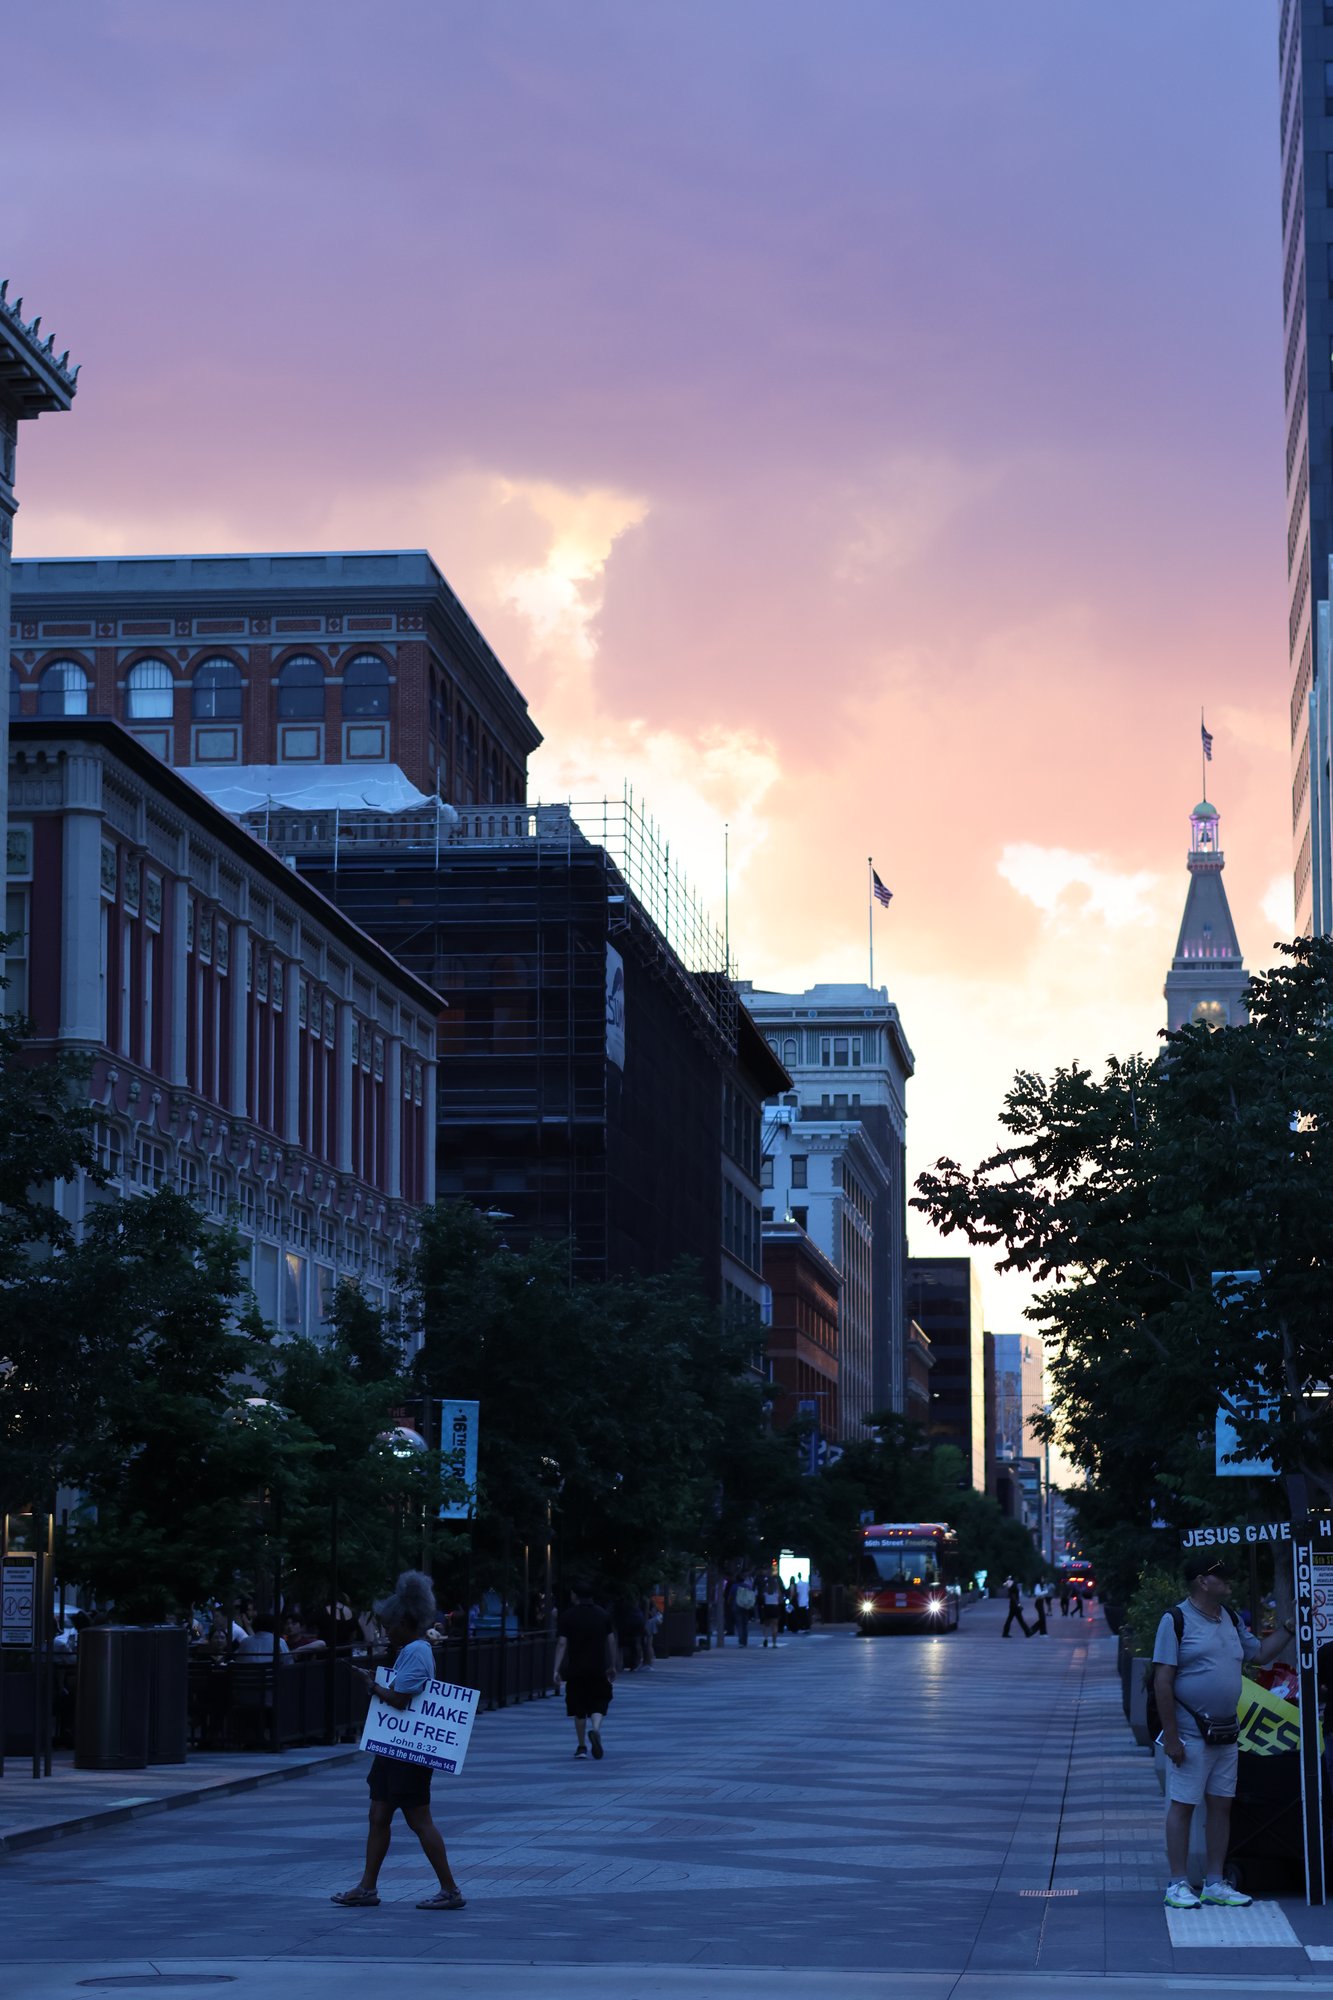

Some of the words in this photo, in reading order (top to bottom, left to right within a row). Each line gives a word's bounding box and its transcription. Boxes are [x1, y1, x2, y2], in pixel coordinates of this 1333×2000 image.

[1182, 1527, 1241, 1548] JESUS
[1245, 1522, 1292, 1543] GAVE
[1298, 1546, 1311, 1598] FOR
[1300, 1606, 1312, 1669] YOU
[420, 1700, 469, 1725] MAKE
[377, 1711, 410, 1733] YOU
[413, 1721, 459, 1746] FREE.
[367, 1742, 388, 1754] Jesus
[388, 1747, 396, 1756] is
[396, 1749, 408, 1759] the
[408, 1752, 428, 1765] truth.
[428, 1760, 443, 1768] John
[390, 1736, 414, 1748] John
[416, 1743, 438, 1754] 8:32
